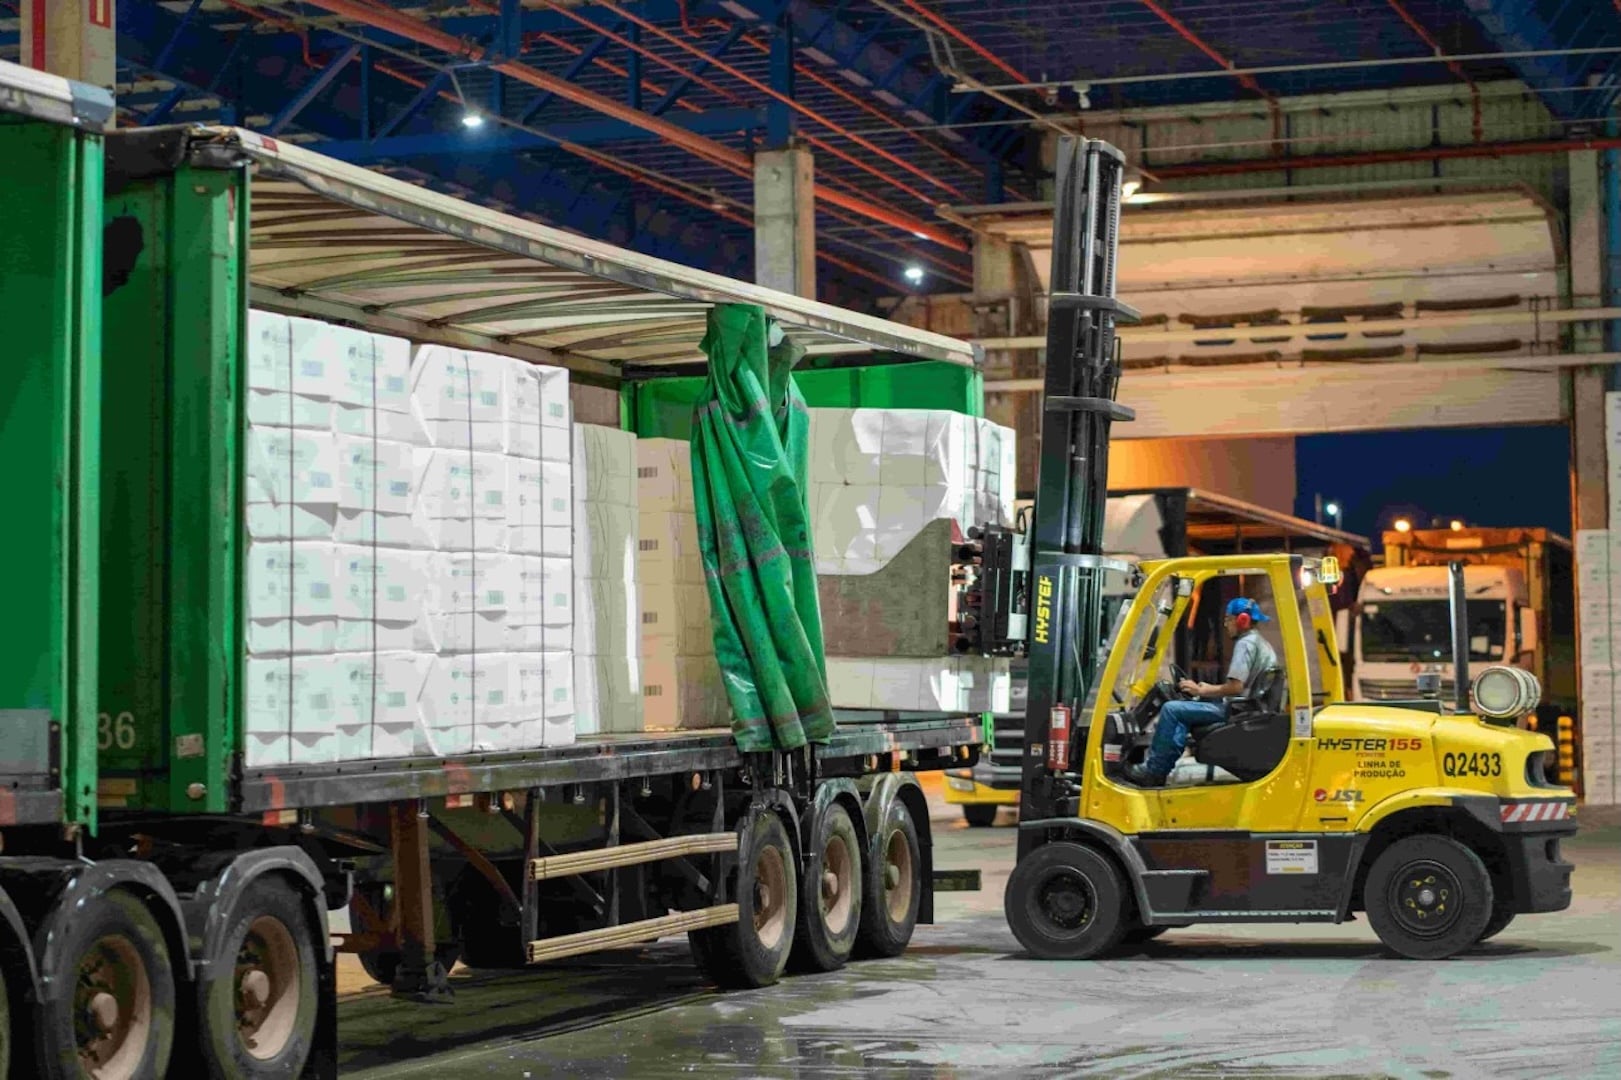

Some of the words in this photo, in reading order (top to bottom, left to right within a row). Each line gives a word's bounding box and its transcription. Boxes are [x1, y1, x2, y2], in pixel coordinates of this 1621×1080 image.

[1318, 738, 1387, 750] HYSTER
[1389, 738, 1422, 751] 155
[1357, 760, 1386, 769] LINHA
[1389, 760, 1401, 768] DE
[1443, 752, 1502, 778] Q2433
[1353, 768, 1406, 779] PRODUÇÃO
